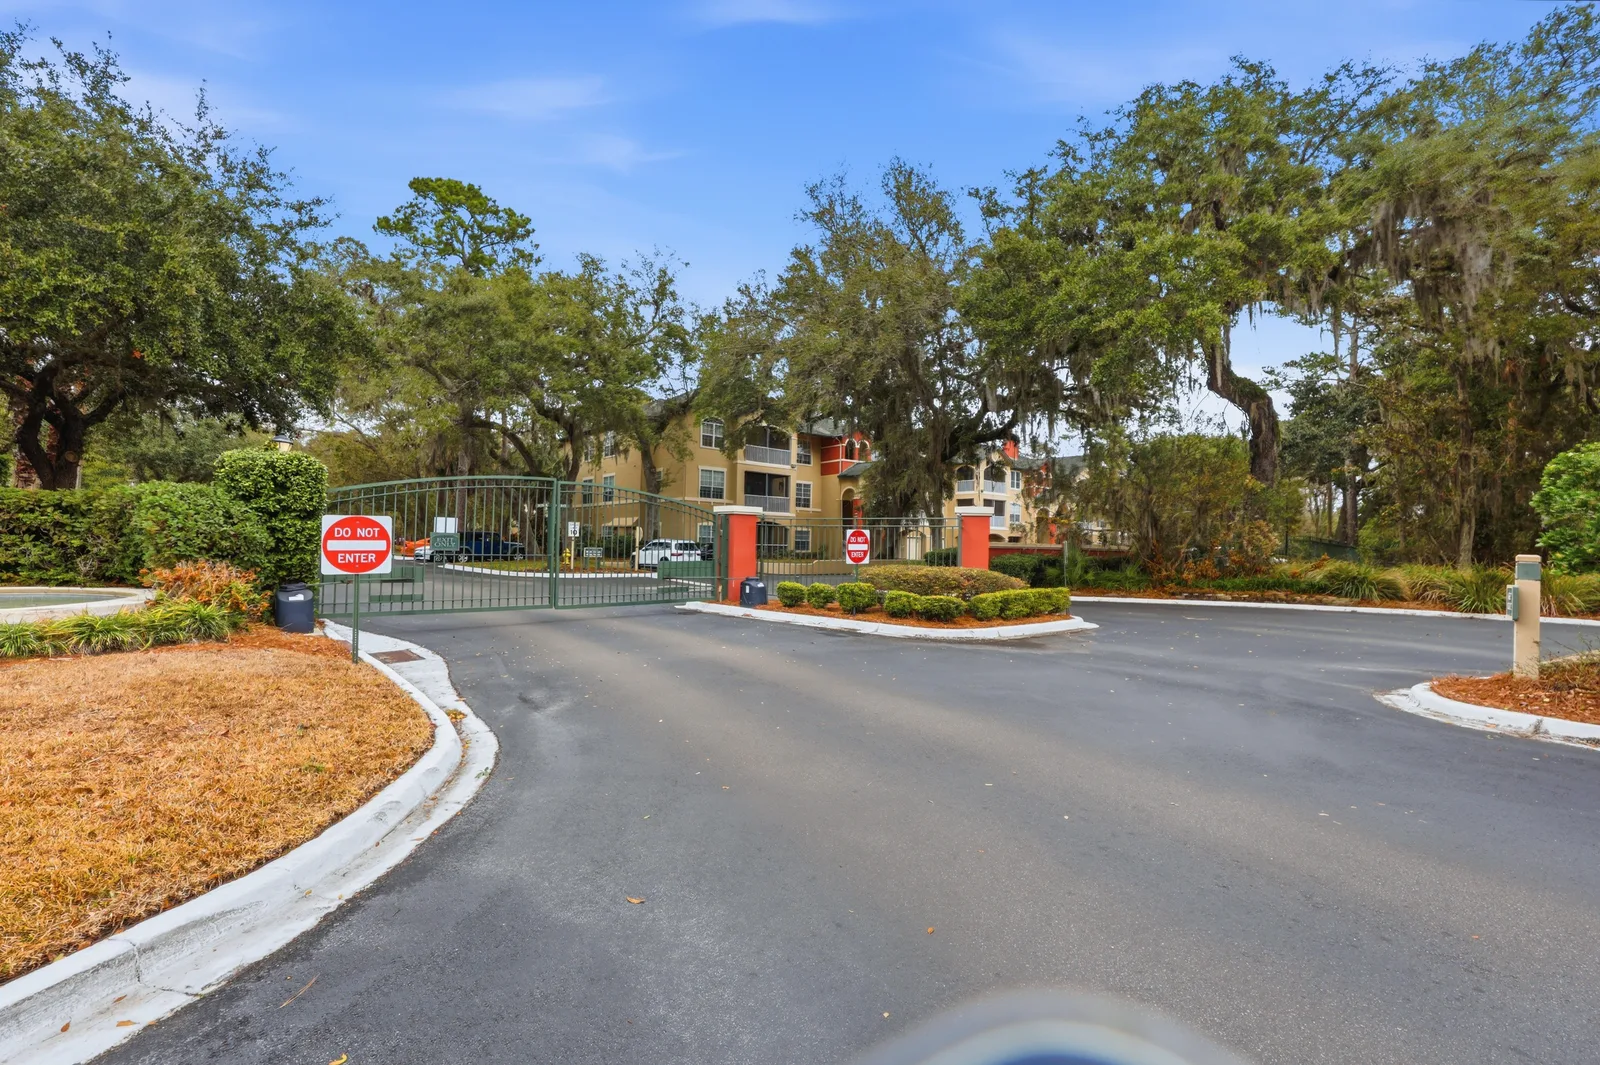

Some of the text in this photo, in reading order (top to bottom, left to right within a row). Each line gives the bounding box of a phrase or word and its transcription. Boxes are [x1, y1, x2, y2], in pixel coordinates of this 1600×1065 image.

[334, 527, 380, 538] DO NOT
[337, 553, 376, 563] ENTER
